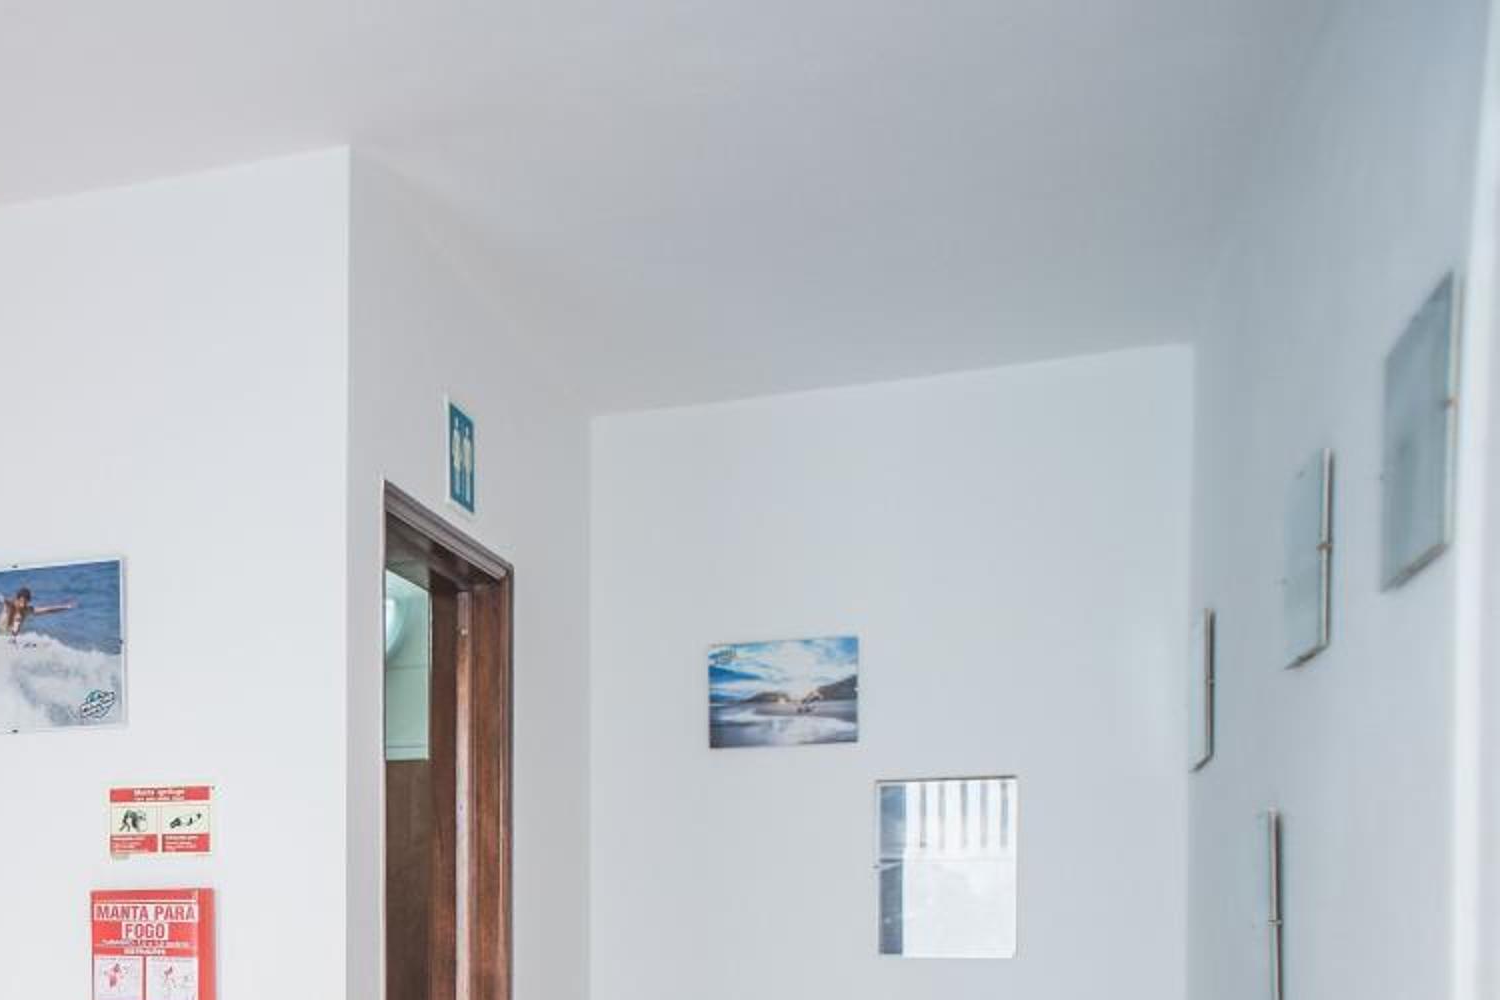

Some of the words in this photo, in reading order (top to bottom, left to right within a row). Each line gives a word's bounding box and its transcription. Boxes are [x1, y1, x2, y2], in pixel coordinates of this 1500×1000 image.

[96, 905, 150, 920] MANTA
[154, 904, 196, 921] PARA
[124, 922, 166, 939] FOGO
